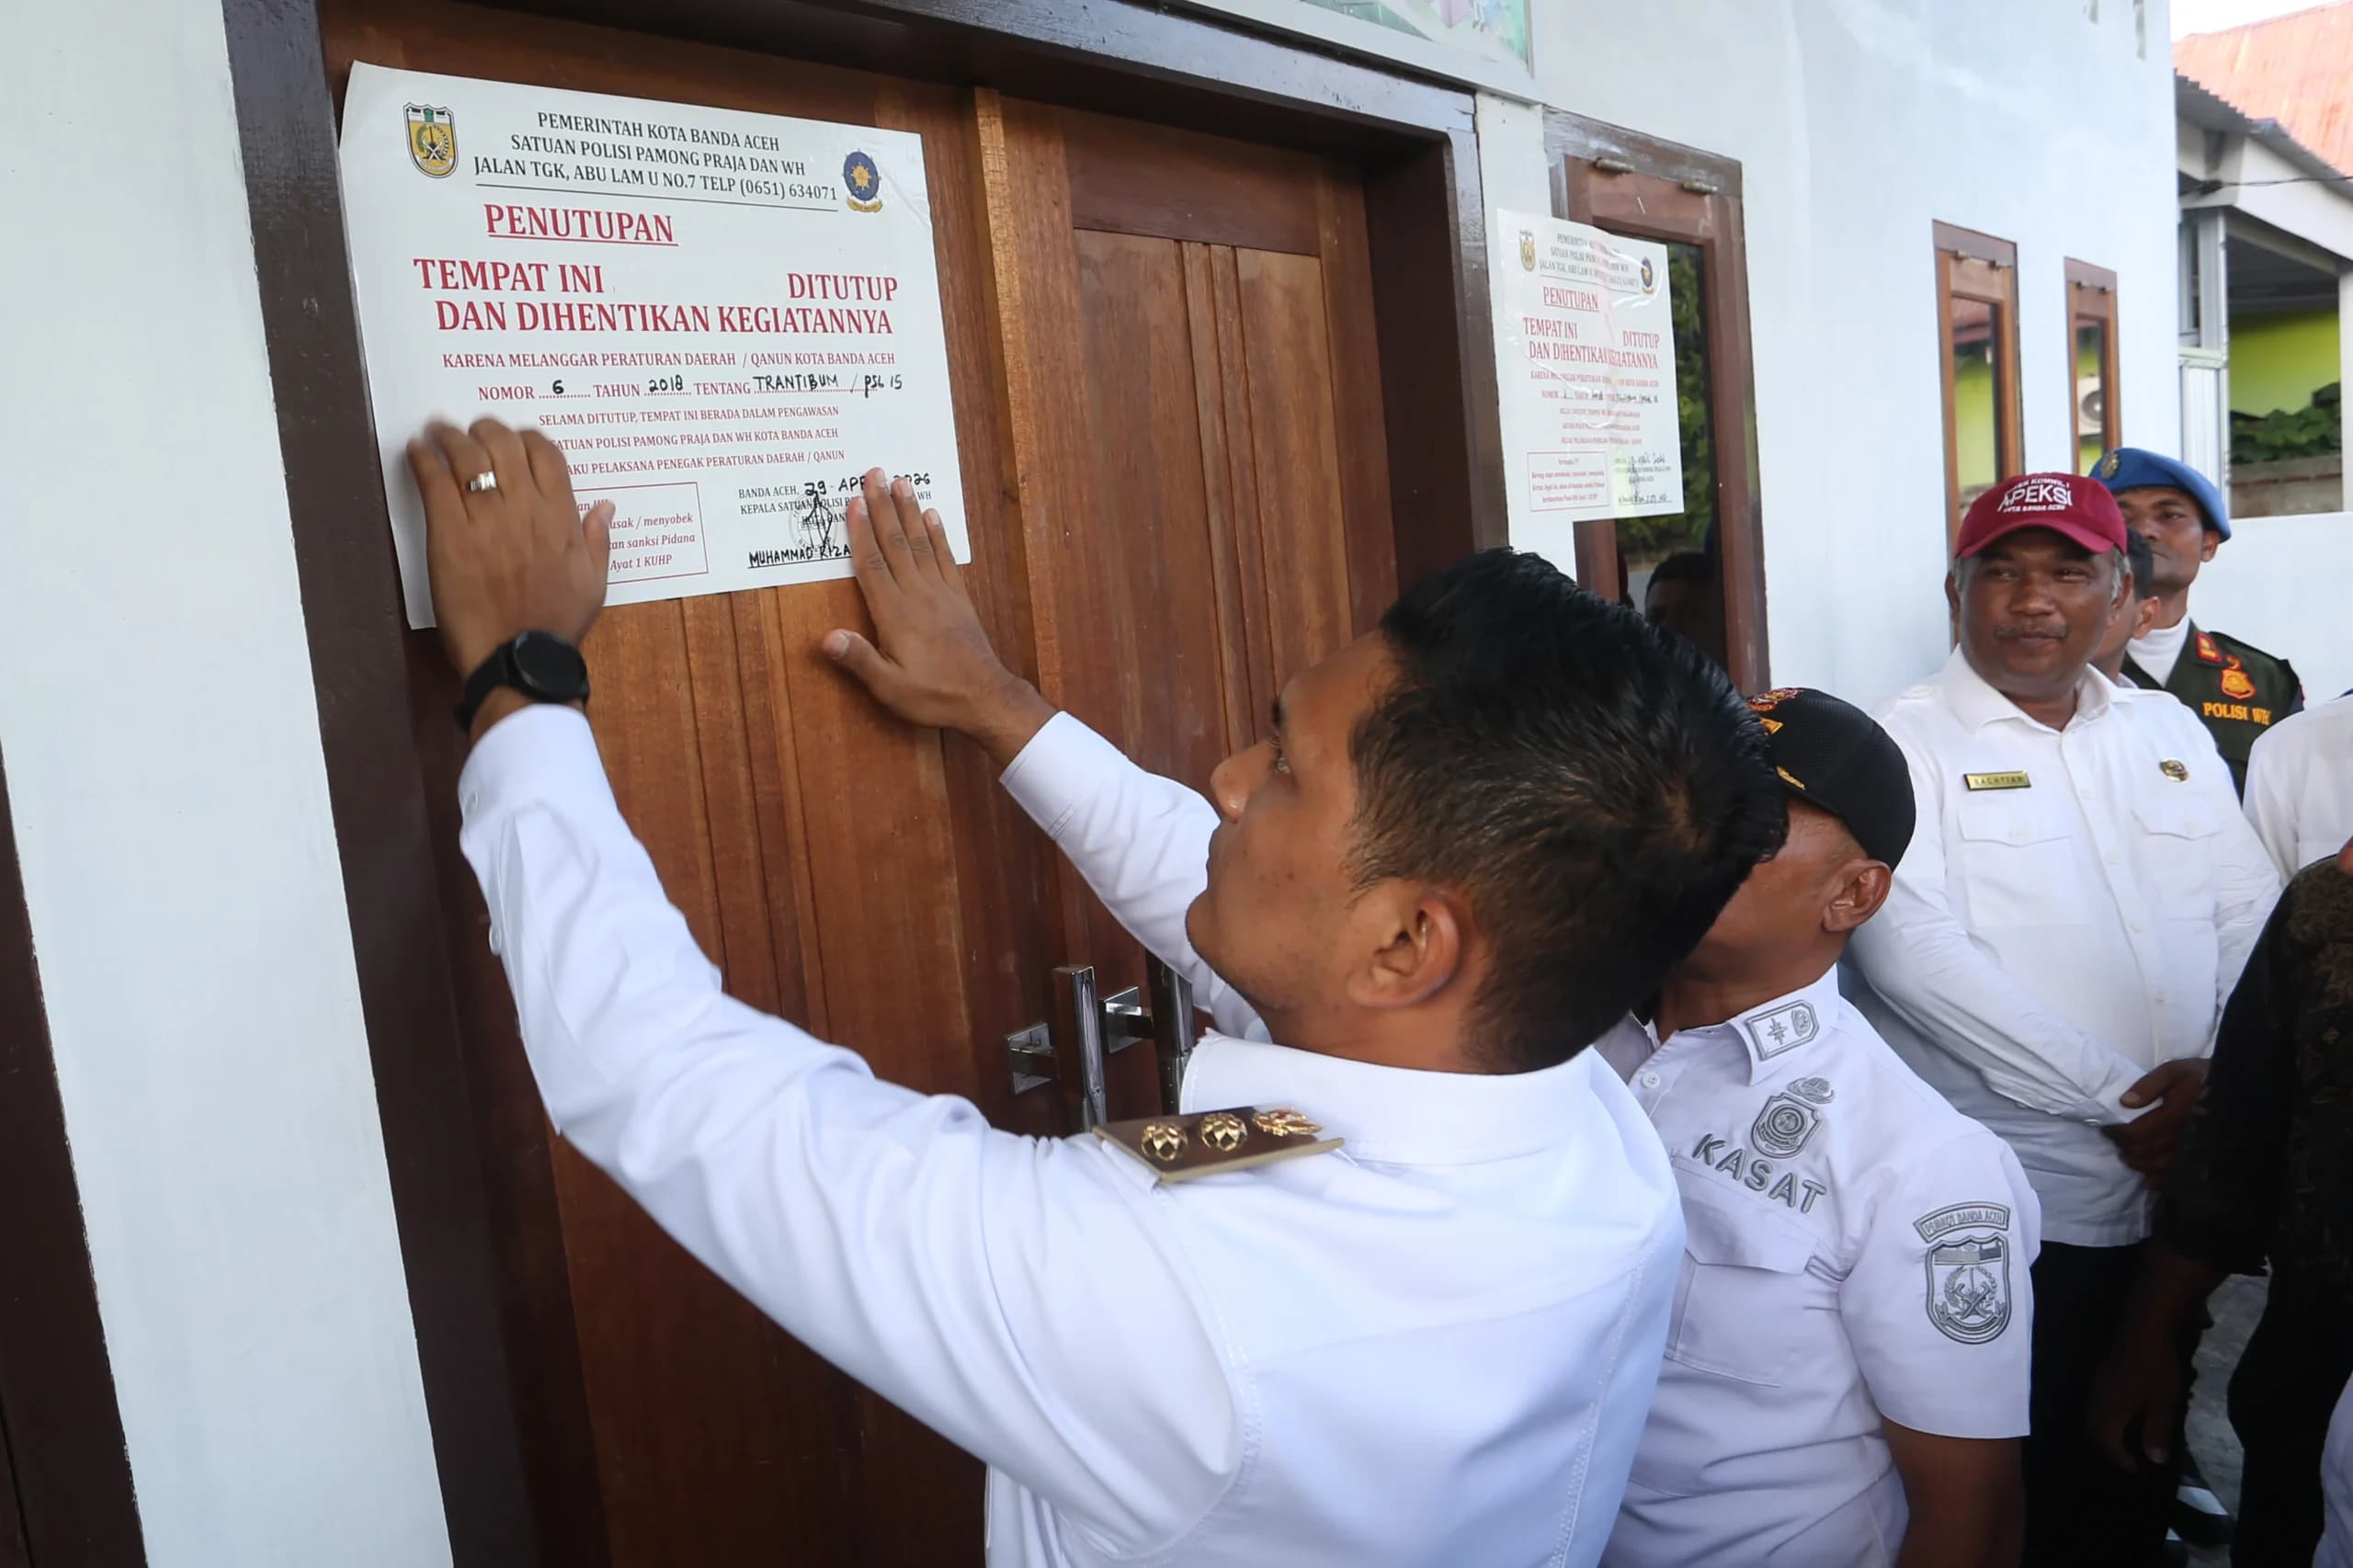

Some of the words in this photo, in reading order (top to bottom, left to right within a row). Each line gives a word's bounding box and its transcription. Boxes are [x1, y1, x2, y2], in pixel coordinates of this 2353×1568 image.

[538, 111, 643, 138] PEMERINTAH
[647, 123, 687, 142] KOTA
[690, 128, 740, 148] BANDA
[744, 135, 779, 151] ACEH
[511, 134, 576, 155] SATUAN
[581, 141, 631, 160] POLISI
[636, 146, 699, 166] PAMONG
[703, 153, 746, 172] PRAJA
[750, 157, 779, 174] DAN
[781, 161, 805, 176] WH
[474, 155, 527, 176] JALAN
[530, 161, 570, 181] TGK,
[574, 165, 607, 182] ABU
[610, 168, 644, 185] LAM
[648, 172, 659, 186] U
[663, 173, 696, 188] NO.7
[699, 176, 735, 191] TELP
[739, 178, 786, 199] (0651)
[789, 184, 837, 200] 634071
[484, 203, 676, 244] PENUTUPAN
[414, 257, 549, 292] TEMPAT
[559, 264, 605, 293] INI
[787, 272, 899, 301] DITUTUP
[1543, 286, 1598, 310] PENUTUPAN
[436, 300, 507, 331] DAN
[516, 301, 710, 333] DIHENTIKAN
[718, 305, 893, 335] KEGIATANNYA
[1523, 317, 1562, 338] TEMPAT
[1564, 322, 1578, 339] INI
[1529, 340, 1550, 359] DAN
[1622, 331, 1660, 348] DITUTUP
[442, 353, 506, 368] KARENA
[509, 353, 598, 368] MELANGGAR
[601, 352, 682, 367] PERATURAN
[685, 352, 736, 366] DAERAH
[742, 352, 748, 368] /
[750, 352, 792, 366] QANUN
[795, 353, 825, 365] KOTA
[827, 352, 865, 365] BANDA
[868, 353, 895, 365] ACEH
[478, 385, 536, 401] NOMOR
[551, 379, 564, 395] 6
[593, 383, 642, 398] TAHUN
[648, 374, 685, 393] 2018
[693, 381, 752, 396] TENTANG
[752, 374, 839, 392] TRANTIBUM
[539, 414, 585, 426] SELAMA
[587, 412, 639, 425] DITUTUP,
[639, 411, 681, 423] TEMPAT
[684, 410, 699, 421] INI
[700, 408, 741, 420] BERADA
[743, 407, 776, 419] DALAM
[778, 405, 839, 418] PENGAWASAN
[596, 437, 631, 449] POLISI
[633, 435, 678, 448] PAMONG
[680, 434, 710, 446] PRAJA
[712, 432, 733, 444] DAN
[734, 431, 753, 443] WH
[755, 430, 779, 441] KOTA
[781, 429, 814, 440] BANDA
[815, 428, 839, 439] ACEH
[592, 461, 654, 474] PELAKSANA
[656, 458, 704, 470] PENEGAK
[706, 455, 765, 467] PERATURAN
[767, 452, 805, 464] DAERAH
[813, 449, 845, 461] QANUN
[738, 487, 771, 499] BANDA
[773, 485, 800, 497] ACEH,
[917, 492, 932, 501] WH
[1997, 484, 2073, 512] APEKSI
[740, 503, 779, 515] KEPALA
[779, 499, 813, 512] SATUAN
[643, 513, 693, 528] menyobek
[627, 536, 659, 549] sanksi
[661, 533, 696, 546] Pidana
[610, 559, 632, 573] Ayat
[635, 557, 641, 568] 1
[643, 554, 673, 567] KUHP
[2202, 702, 2249, 721] POLISI
[2252, 707, 2272, 726] WH
[1691, 1132, 1827, 1214] KASAT
